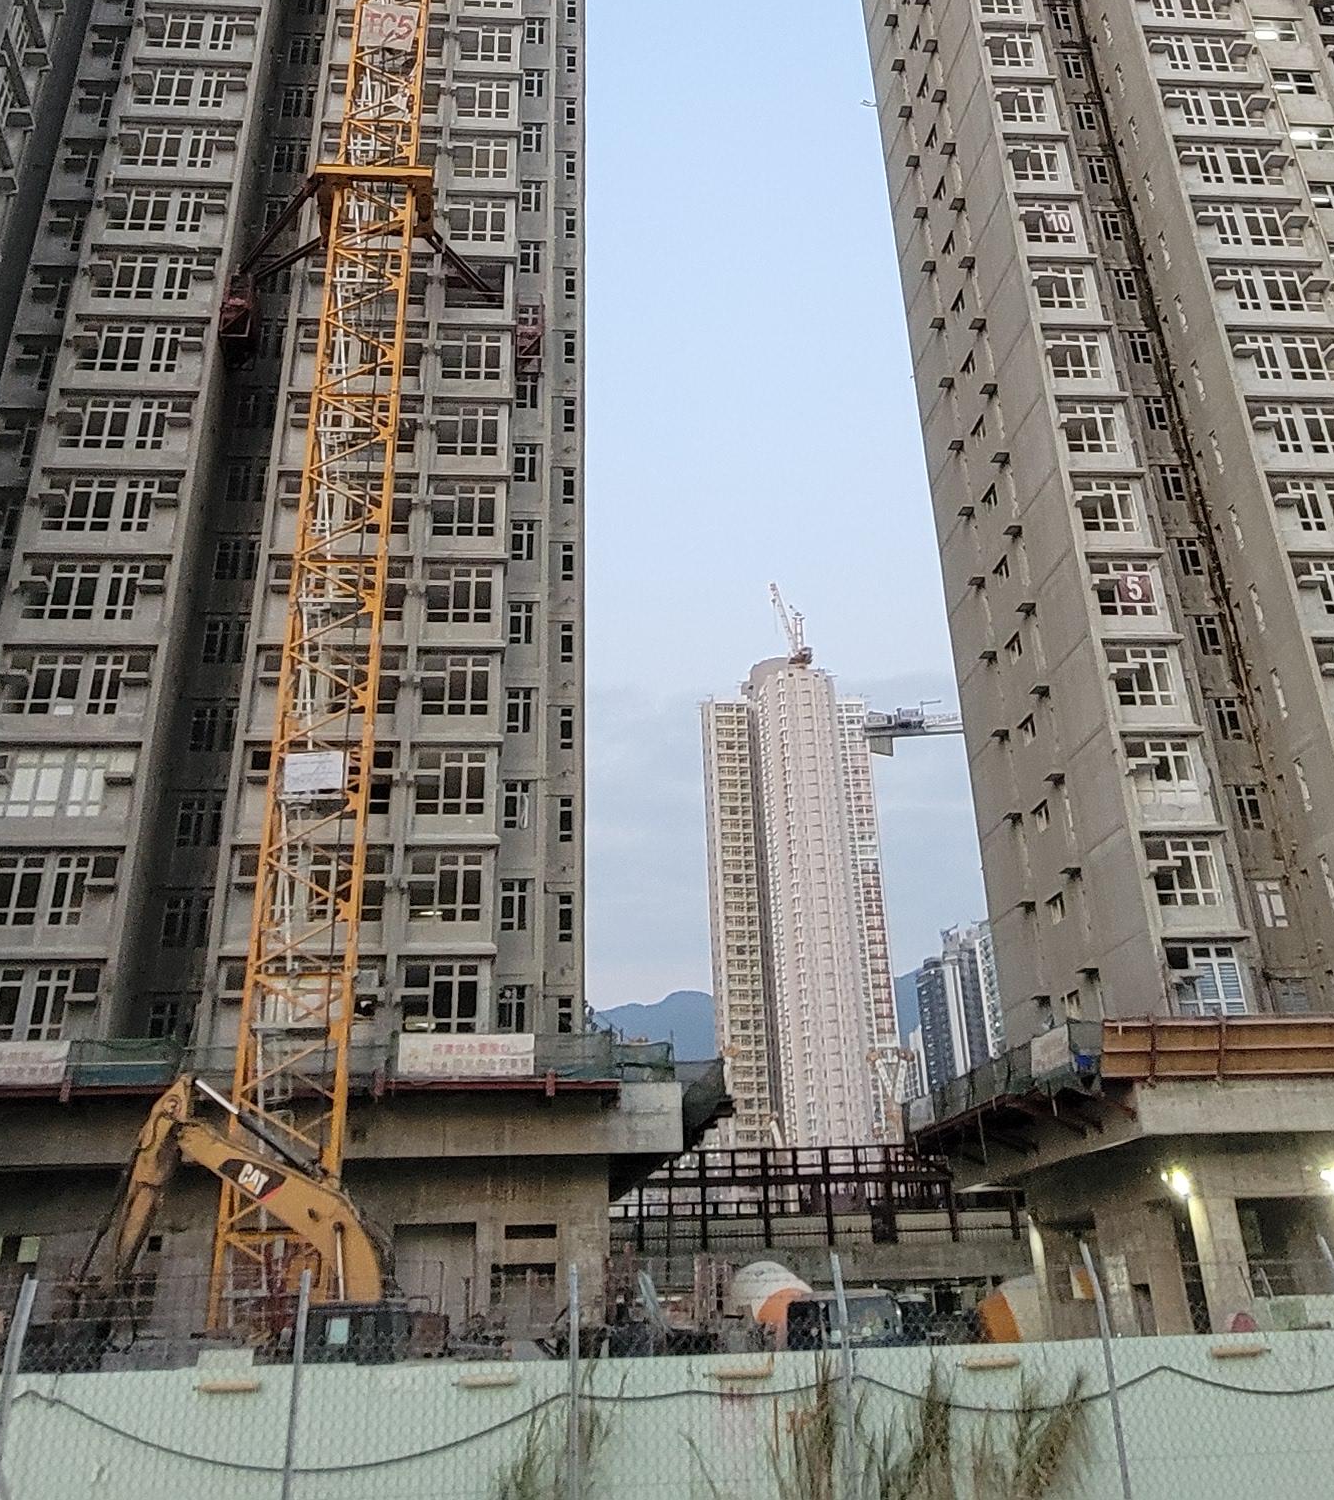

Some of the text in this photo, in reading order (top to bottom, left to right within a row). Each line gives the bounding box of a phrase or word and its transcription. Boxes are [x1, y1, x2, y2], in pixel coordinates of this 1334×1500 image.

[365, 12, 413, 41] TC5
[1047, 213, 1070, 232] 10
[1127, 576, 1143, 600] 5
[237, 1163, 270, 1195] CAT
